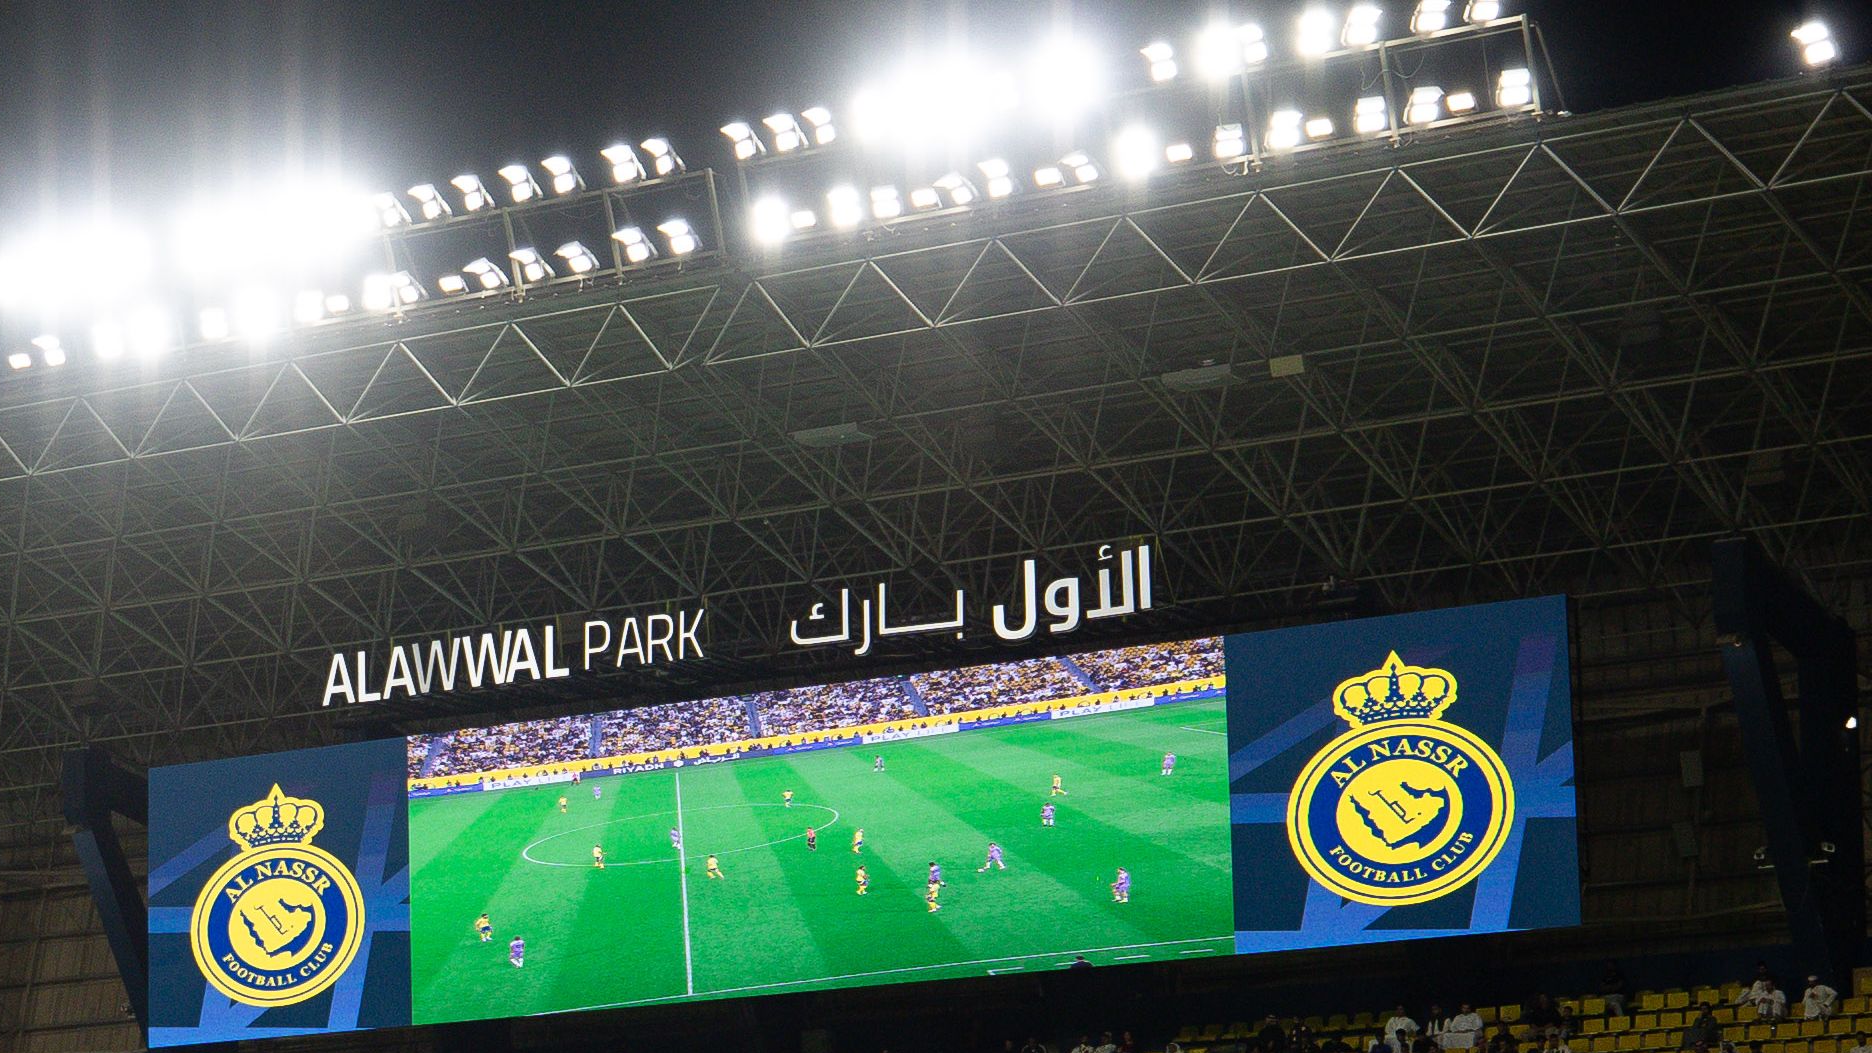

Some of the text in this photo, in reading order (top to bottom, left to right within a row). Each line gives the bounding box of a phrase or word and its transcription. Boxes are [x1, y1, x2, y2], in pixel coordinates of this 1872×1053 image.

[791, 544, 1152, 656] الأول بارك
[322, 608, 705, 706] ALAWWAL PARK
[613, 763, 664, 775] RIYADH
[1330, 738, 1469, 788] AL NASSR
[224, 860, 331, 904] AL NASSR
[1329, 832, 1474, 883] FOOTBALL CLUB
[222, 942, 334, 987] FOOTBALL CLUB
